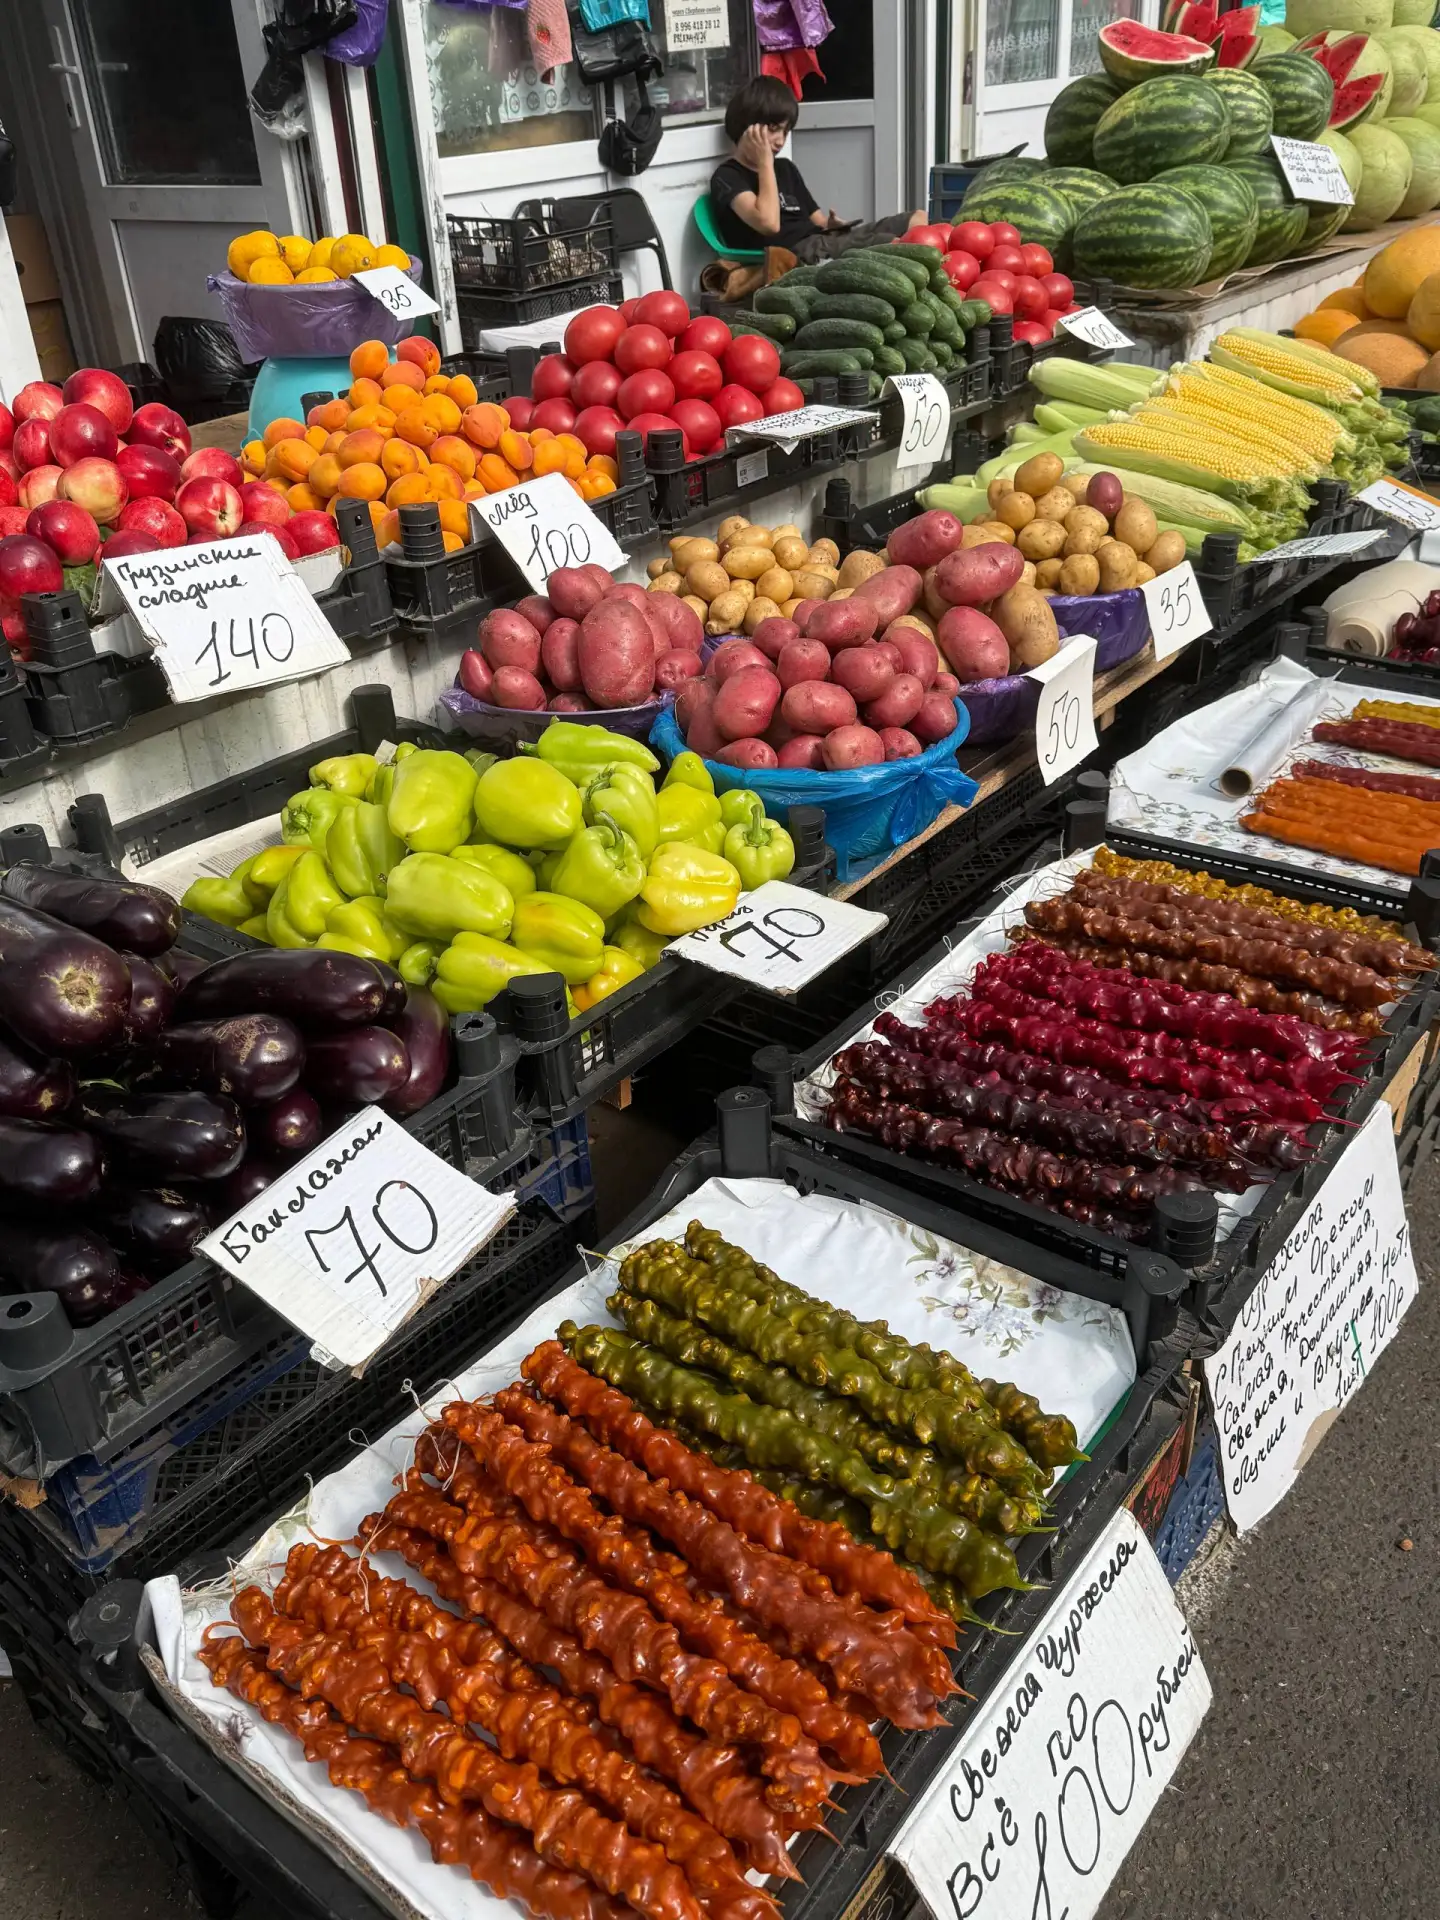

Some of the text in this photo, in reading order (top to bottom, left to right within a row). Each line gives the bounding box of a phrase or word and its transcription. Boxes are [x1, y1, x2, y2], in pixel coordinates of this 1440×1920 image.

[381, 284, 412, 310] 35
[905, 393, 942, 452] 50
[117, 546, 262, 589] Грузинские
[526, 523, 591, 581] 100
[1160, 576, 1192, 631] 35
[194, 612, 294, 686] 140
[1045, 690, 1080, 764] 50
[719, 907, 826, 962] 70
[219, 1121, 383, 1263] Баклажан
[1310, 1173, 1374, 1276] Орехом
[304, 1180, 438, 1297] 70
[1223, 1352, 1274, 1435] Самая
[1294, 1392, 1303, 1415] и
[947, 1692, 1087, 1920] Всё по
